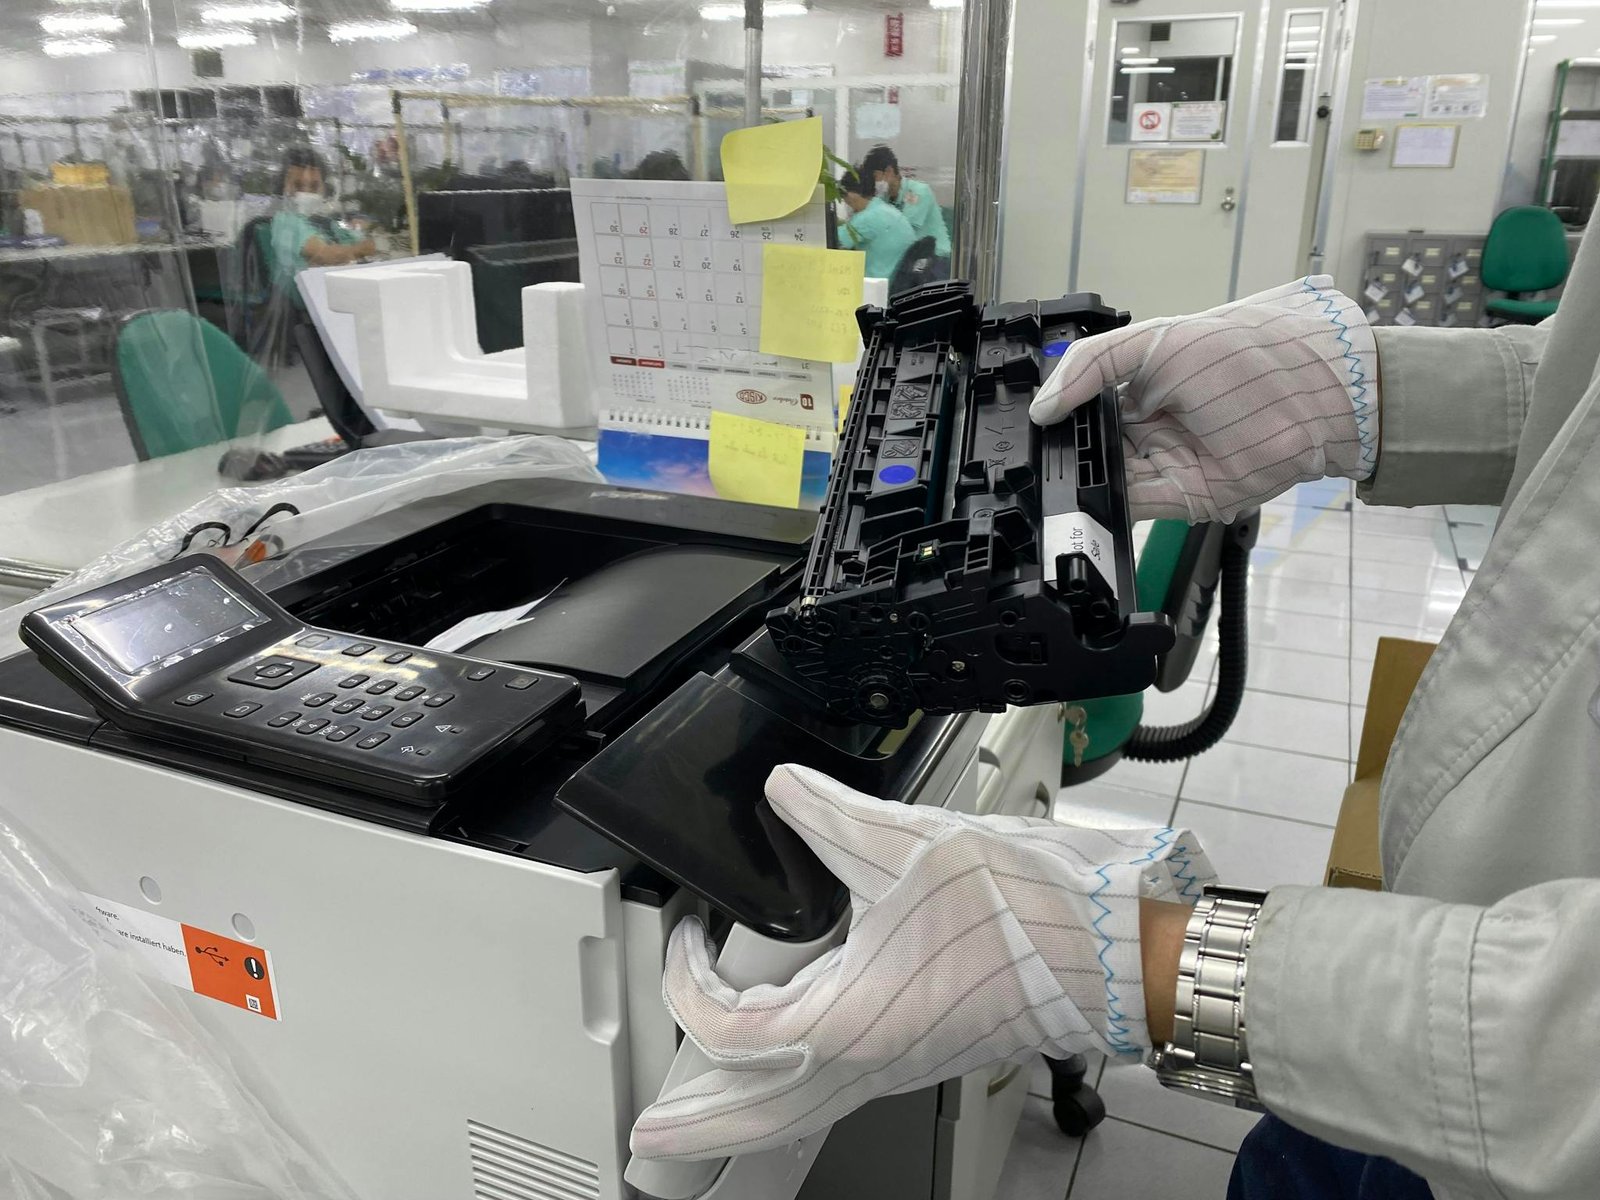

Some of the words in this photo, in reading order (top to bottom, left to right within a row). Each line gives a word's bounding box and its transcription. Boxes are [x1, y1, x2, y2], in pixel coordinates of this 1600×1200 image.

[640, 226, 648, 234] 29
[794, 233, 804, 241] 24
[643, 258, 651, 266] 22
[1070, 527, 1084, 540] for
[129, 931, 162, 949] installiert
[162, 943, 187, 957] haben.
